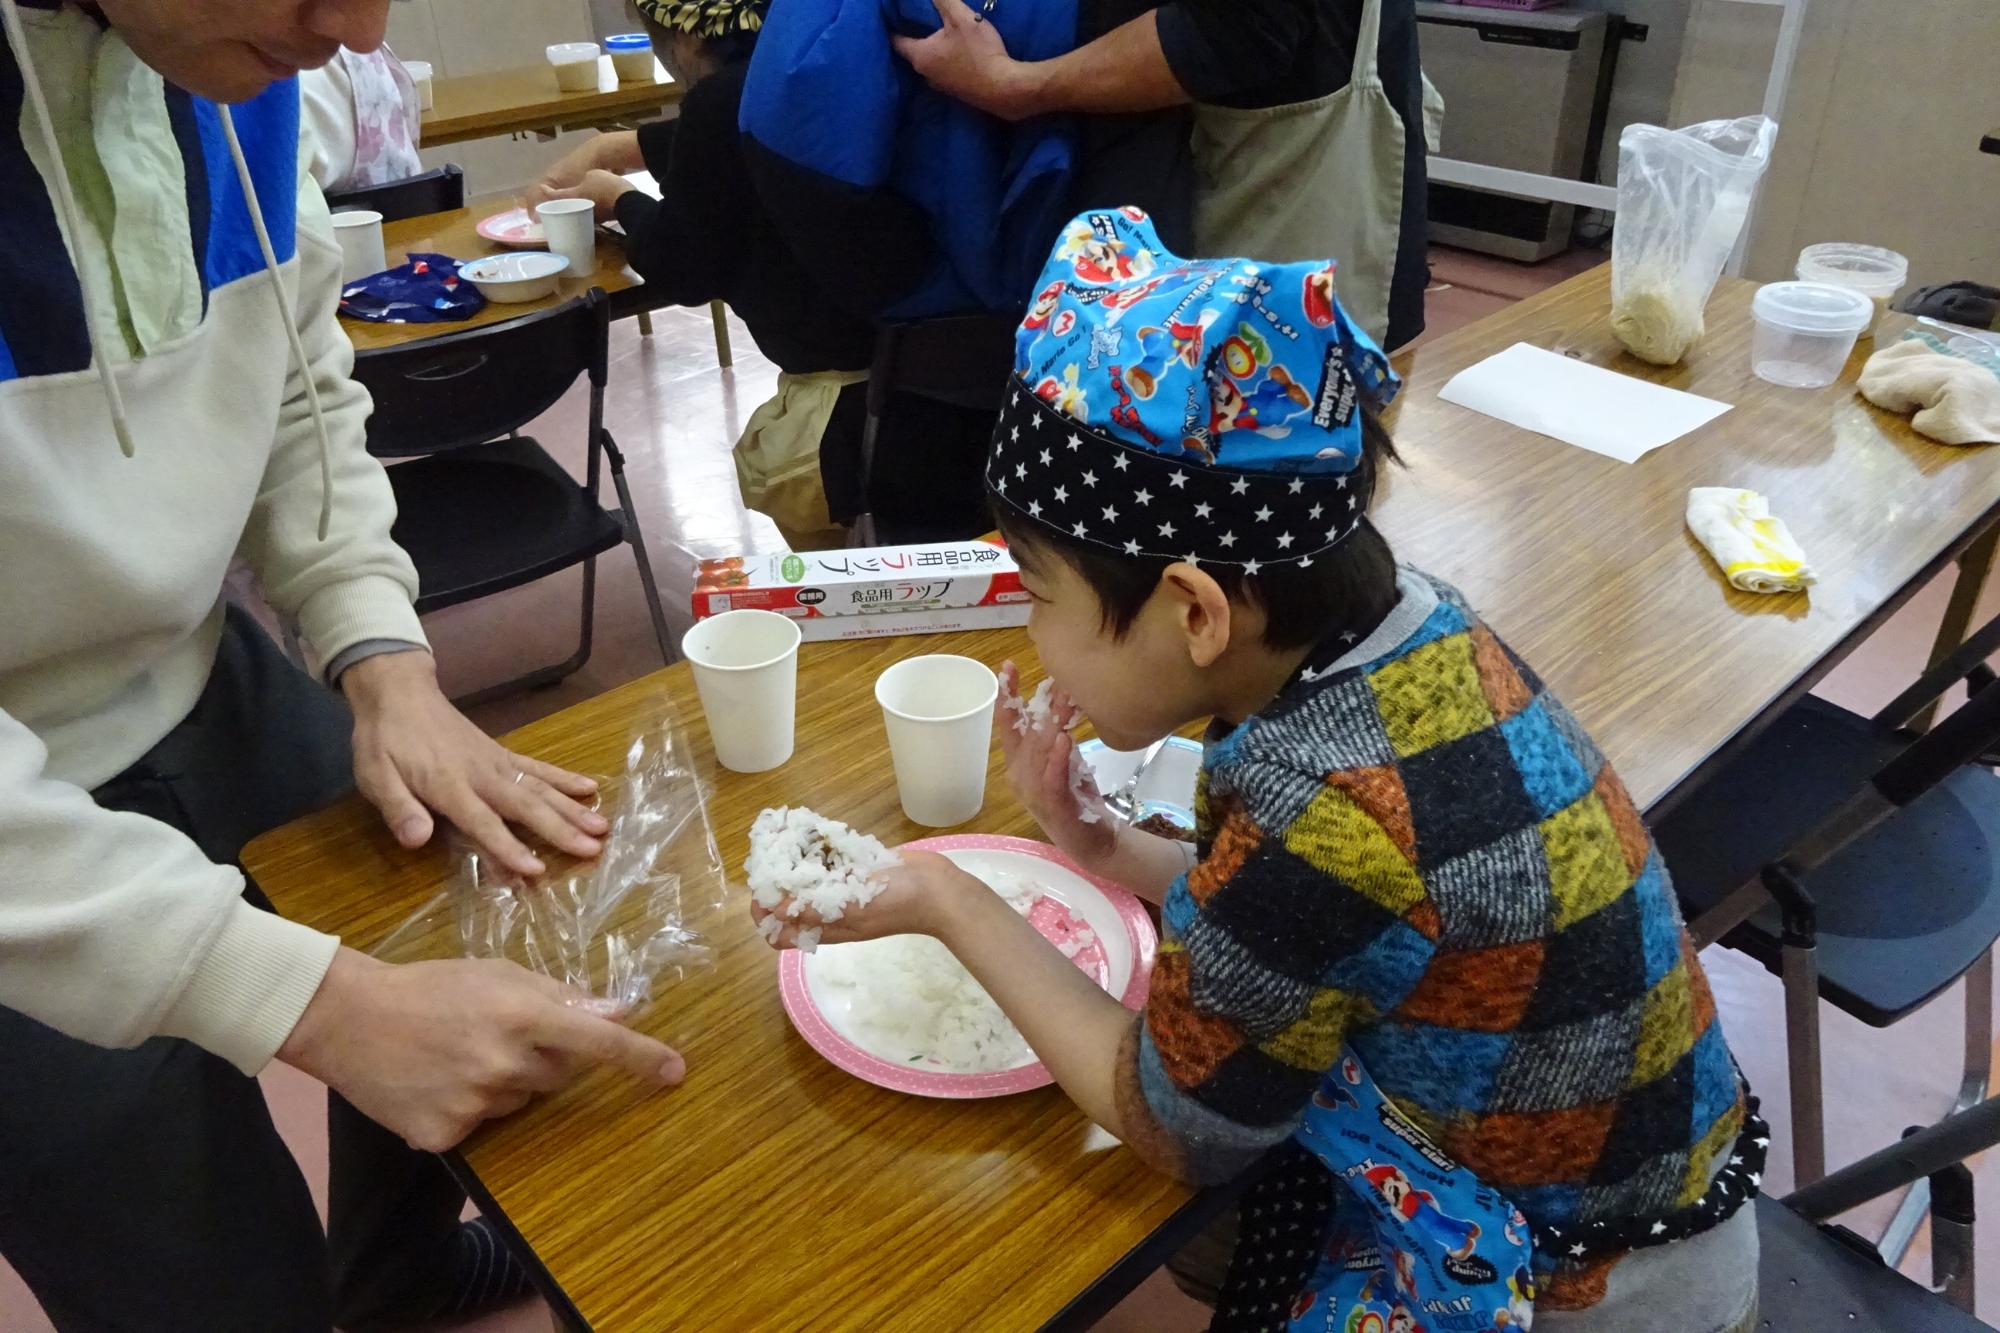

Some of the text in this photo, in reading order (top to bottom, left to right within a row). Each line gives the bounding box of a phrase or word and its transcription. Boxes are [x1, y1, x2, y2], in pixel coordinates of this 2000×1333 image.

[819, 547, 1000, 576] 食品用ラップ
[850, 578, 954, 604] 食品用ラップ
